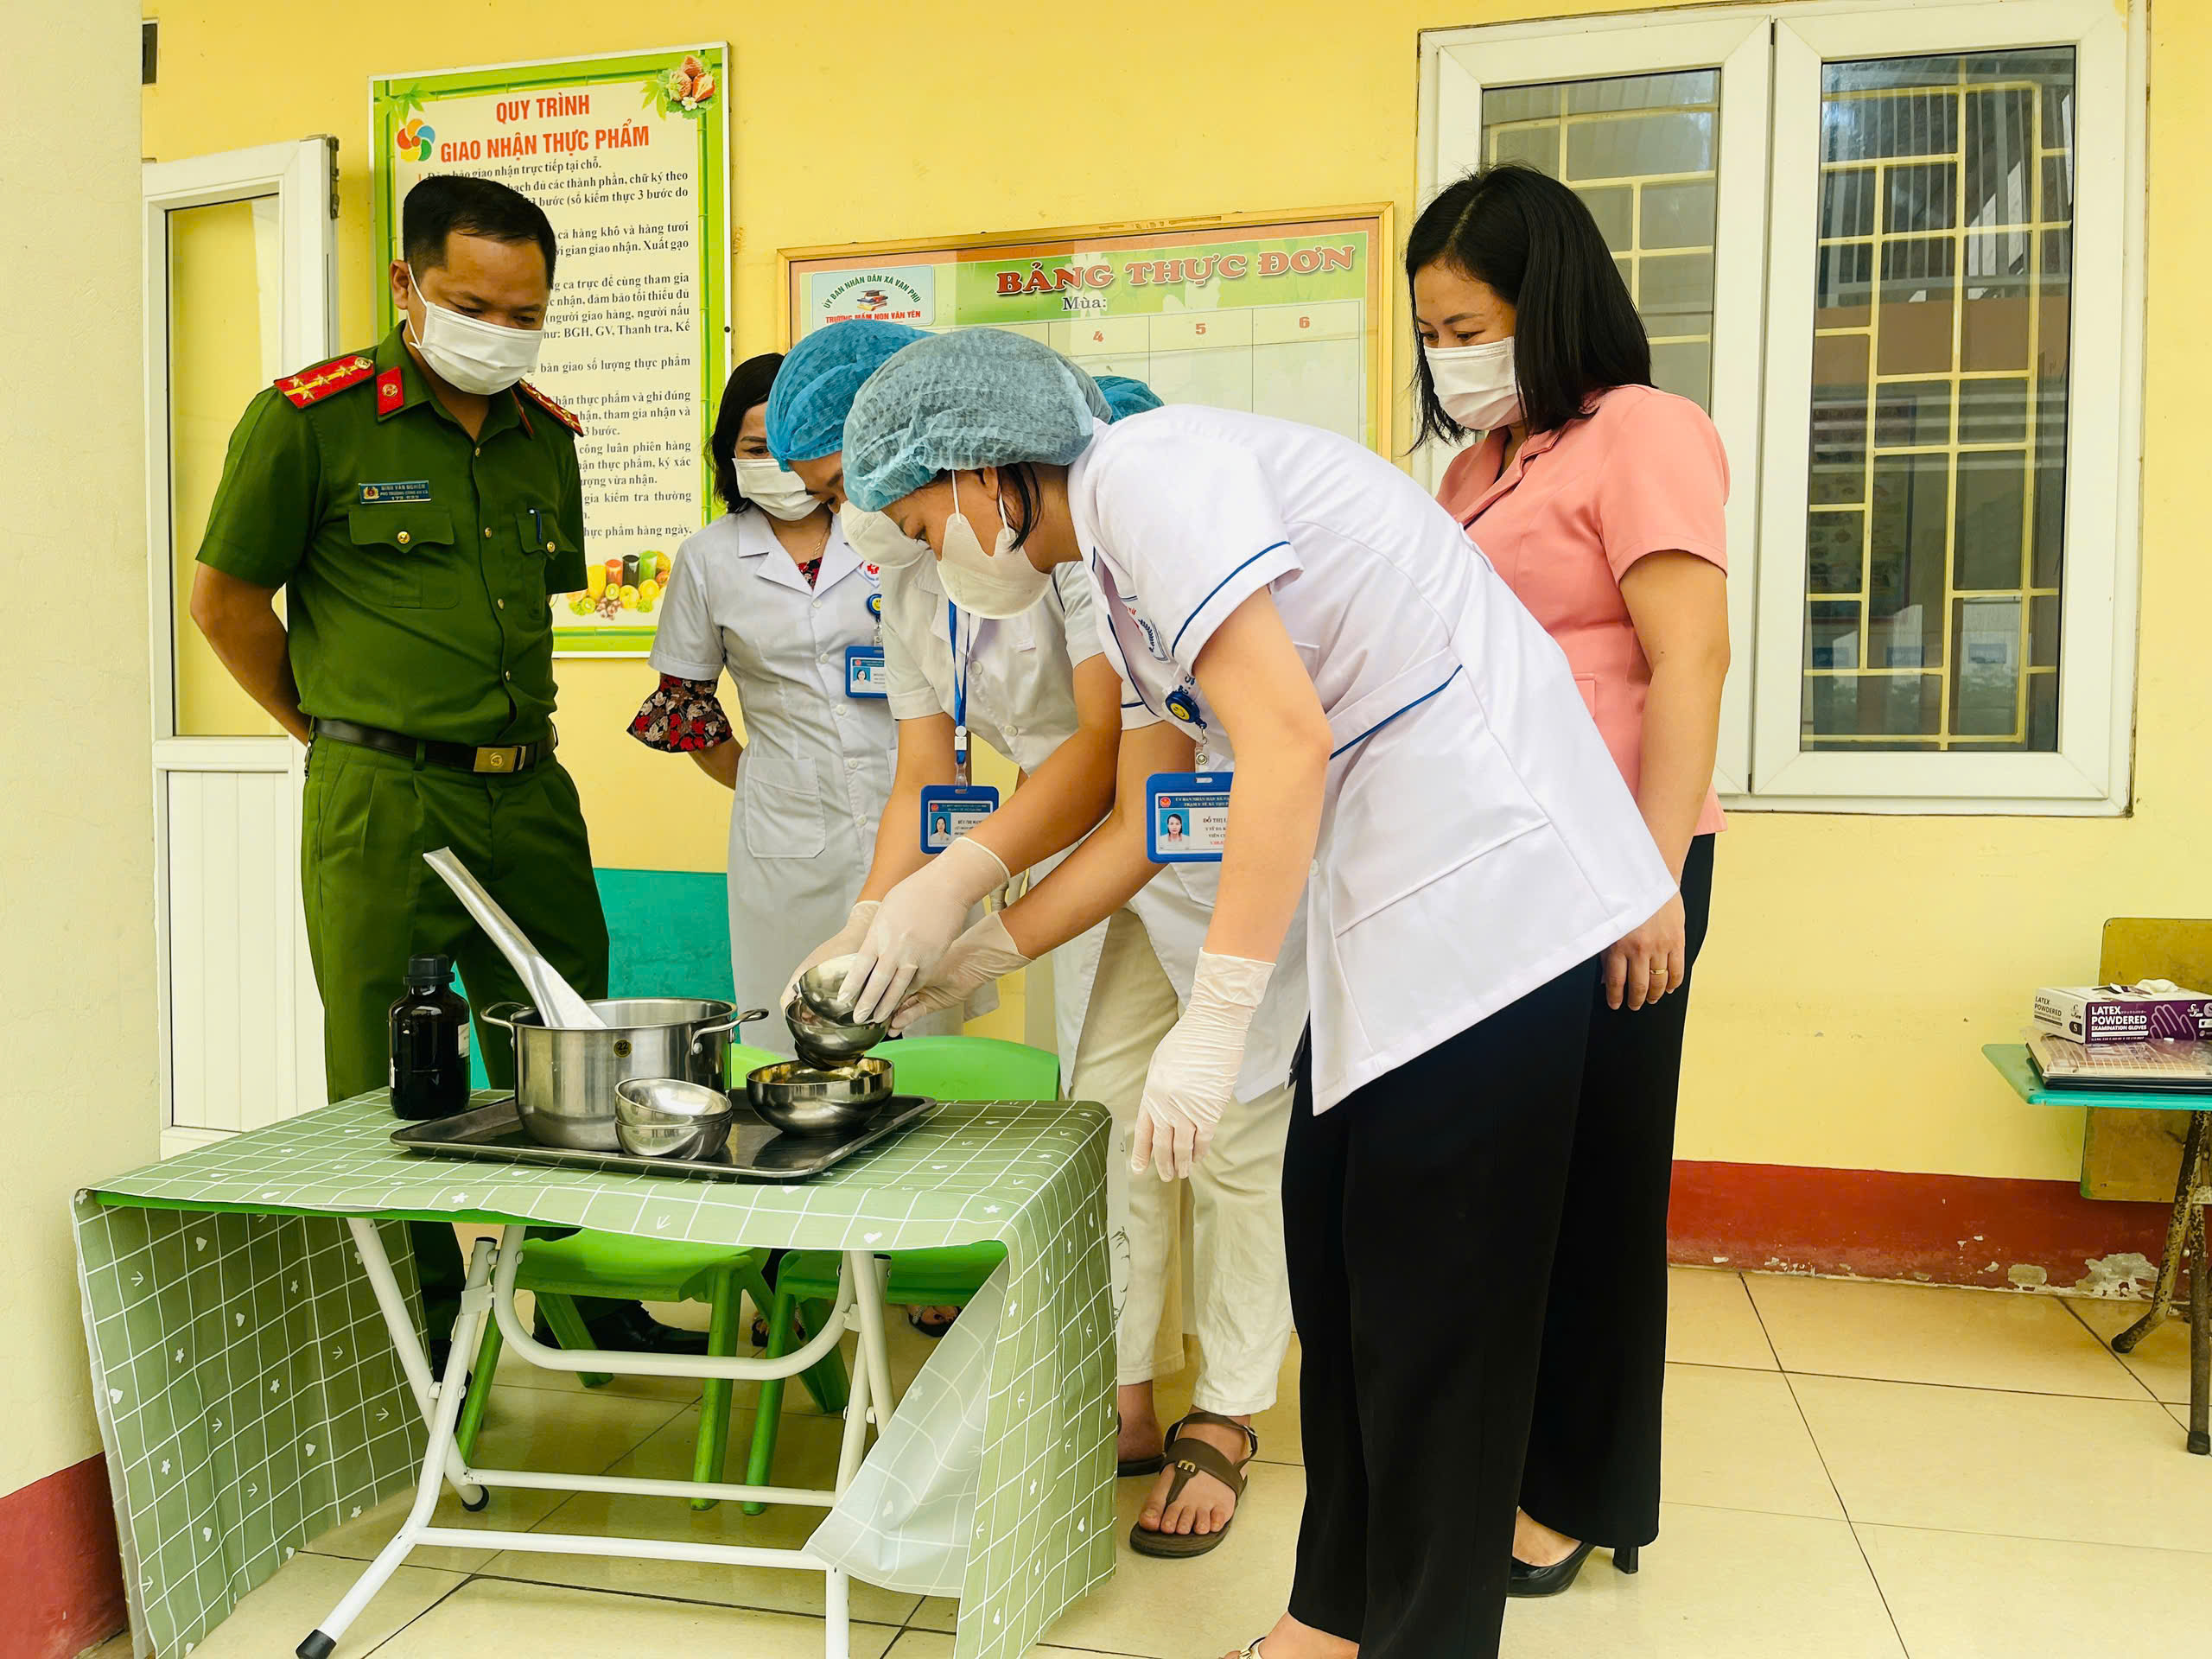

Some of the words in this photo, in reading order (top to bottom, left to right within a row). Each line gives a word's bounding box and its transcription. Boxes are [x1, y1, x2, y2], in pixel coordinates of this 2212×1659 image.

[496, 100, 531, 125] QUY
[537, 92, 590, 118] TRÌNH
[441, 140, 481, 162] GIAO
[487, 132, 537, 161] NHẬN
[543, 130, 589, 156] THỰC
[595, 118, 649, 150] PHẨM
[495, 165, 519, 177] nhận
[522, 164, 543, 176] trực
[545, 159, 563, 174] tiếp
[566, 160, 579, 173] tại
[533, 180, 546, 191] đủ
[549, 179, 565, 190] các
[567, 177, 596, 188] thành
[630, 173, 649, 183] chữ
[651, 172, 664, 185] ký
[666, 171, 688, 181] theo
[539, 195, 563, 207] bước
[584, 190, 609, 204] kiểm
[612, 192, 635, 205] thực
[638, 190, 644, 200] 3
[647, 188, 672, 200] bước
[675, 187, 688, 197] do
[572, 228, 597, 240] hàng
[601, 226, 620, 237] khô
[623, 225, 635, 235] và
[639, 223, 664, 236] hàng
[667, 220, 689, 232] tươi
[565, 245, 587, 257] gian
[589, 243, 610, 257] giao
[643, 236, 669, 251] Xuất
[671, 239, 689, 252] gạo
[996, 262, 1114, 296] BẢNG
[1125, 253, 1248, 286] THỰC
[1258, 245, 1355, 276] ĐƠN
[563, 281, 574, 289] ca
[577, 279, 599, 291] trực
[601, 274, 613, 287] để
[616, 276, 641, 288] cùng
[645, 275, 671, 285] tham
[674, 272, 689, 285] gia
[830, 287, 845, 300] BAN
[844, 276, 866, 289] NHÂN
[867, 273, 882, 283] DÂN
[588, 293, 609, 304] đảm
[612, 292, 630, 303] bảo
[632, 289, 645, 302] tối
[648, 287, 673, 300] thiểu
[677, 289, 690, 299] đủ
[1062, 296, 1106, 310] Mùa:
[545, 311, 579, 325] (người
[582, 310, 603, 323] giao
[638, 306, 667, 319] người
[671, 302, 690, 316] nấu
[618, 324, 651, 335] Thanh
[676, 318, 690, 332] Kế
[1195, 323, 1206, 335] 5
[1299, 316, 1311, 328] 6
[1093, 331, 1104, 342] 4
[540, 362, 559, 373] bản
[563, 361, 583, 374] giao
[587, 357, 598, 370] số
[601, 359, 631, 372] lượng
[634, 358, 658, 370] thực
[661, 353, 690, 370] phẩm
[553, 395, 574, 408] hận
[576, 395, 599, 408] thực
[601, 391, 630, 406] phẩm
[632, 391, 645, 402] và
[646, 391, 663, 404] ghi
[664, 390, 690, 402] đúng
[604, 409, 630, 419] tham
[632, 408, 647, 421] gia
[650, 406, 677, 420] nhận
[679, 406, 690, 416] và
[584, 426, 590, 436] 3
[579, 443, 603, 455] công
[607, 442, 629, 454] luân
[632, 442, 661, 454] phiên
[665, 441, 691, 453] hàng
[598, 460, 620, 472] thực
[658, 457, 671, 470] ký
[674, 456, 691, 467] xác
[581, 478, 607, 488] ượng
[584, 493, 599, 505] gia
[604, 490, 629, 503] kiểm
[634, 493, 649, 502] tra
[654, 491, 691, 503] thường
[583, 527, 602, 539] hực
[605, 523, 634, 538] phẩm
[637, 525, 662, 537] hàng
[2035, 996, 2050, 1006] LATEX
[2035, 1003, 2062, 1016] POWDERED
[2091, 1006, 2121, 1015] LATEX
[2091, 1015, 2147, 1025] POWDERED
[618, 1042, 628, 1051] 22
